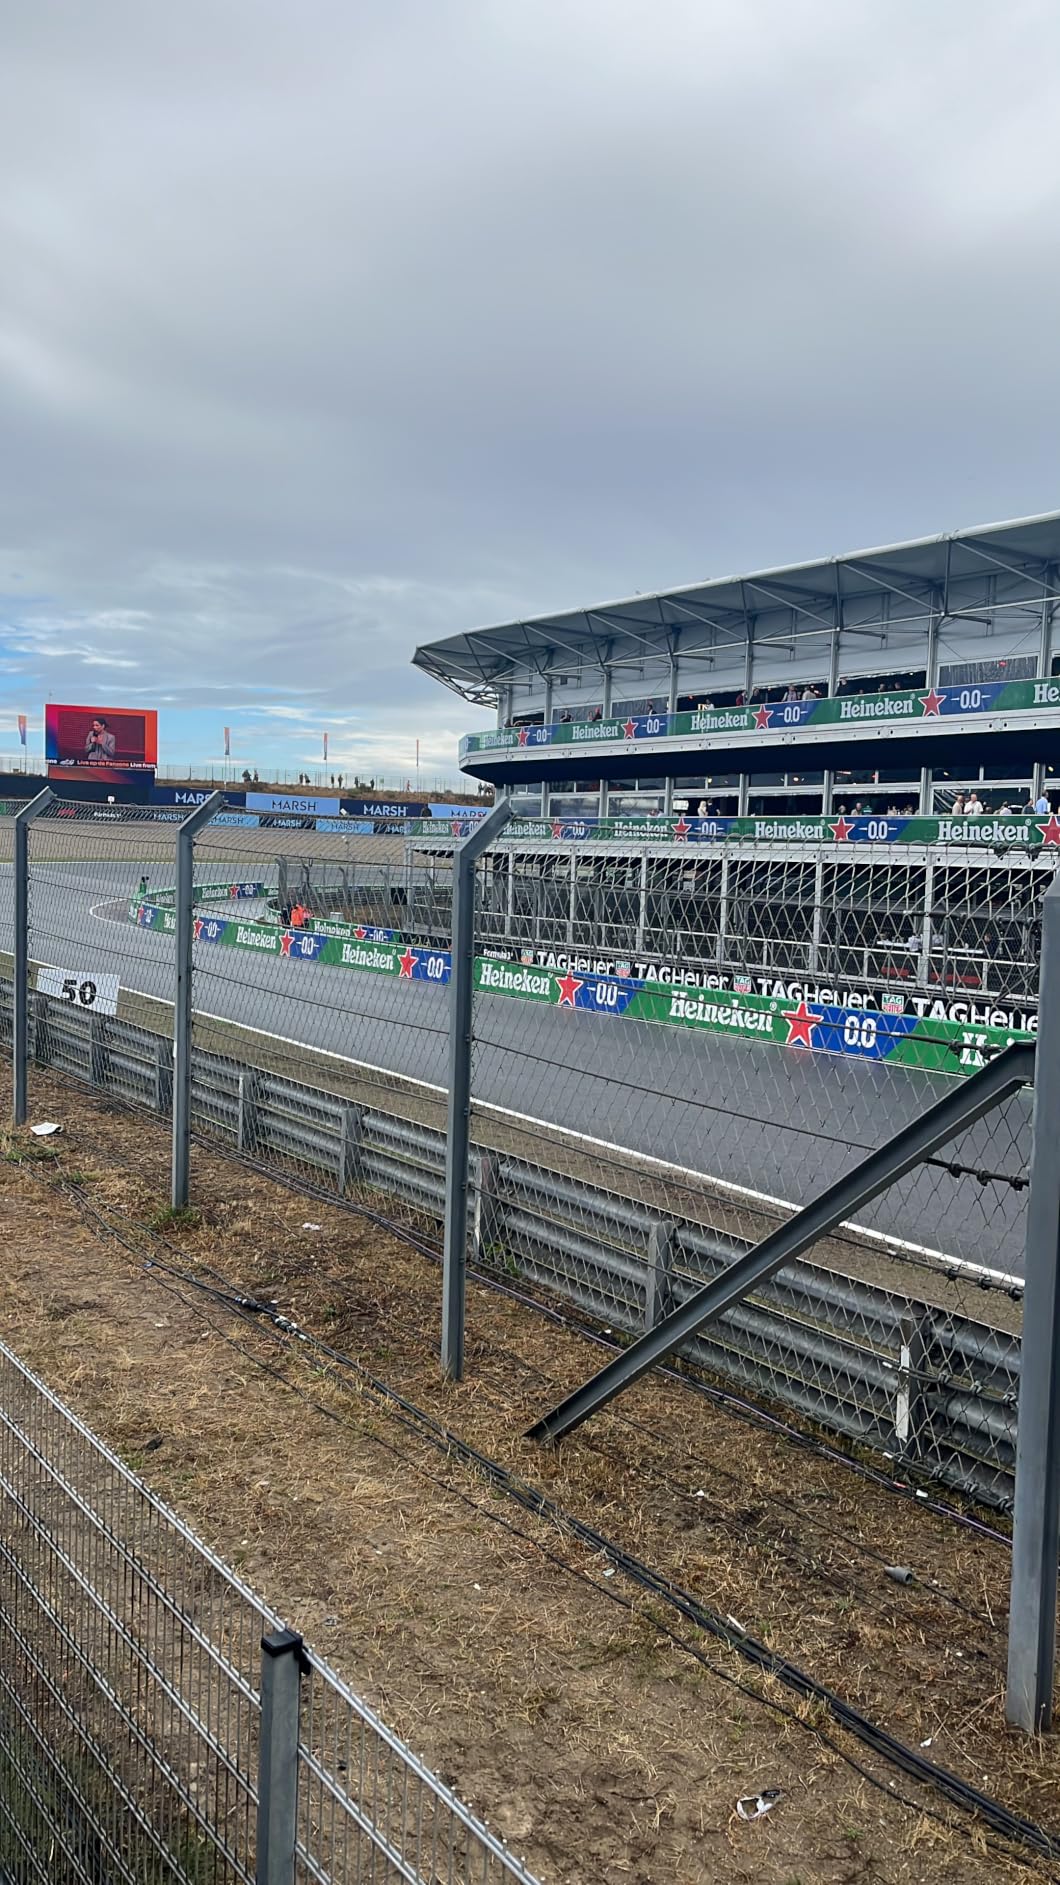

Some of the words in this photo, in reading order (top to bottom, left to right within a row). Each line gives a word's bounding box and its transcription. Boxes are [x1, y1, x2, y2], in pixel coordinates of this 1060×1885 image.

[1033, 683, 1060, 703] He
[840, 697, 914, 719] Heineken
[691, 712, 748, 731] Heineken
[484, 733, 513, 746] Heineken
[572, 724, 618, 740] Heineken
[272, 800, 316, 811] MARSH
[363, 804, 407, 817] MARSH
[214, 815, 244, 824] MARSH
[273, 819, 301, 828] MARSH
[614, 821, 668, 837] Heineken
[755, 820, 824, 839] Heineken
[937, 820, 1029, 841] Heineken
[236, 926, 277, 949] Heineken
[341, 943, 394, 970] Heineken
[479, 963, 550, 995] Heineken
[62, 979, 97, 1006] 50
[669, 990, 774, 1032] Heineken
